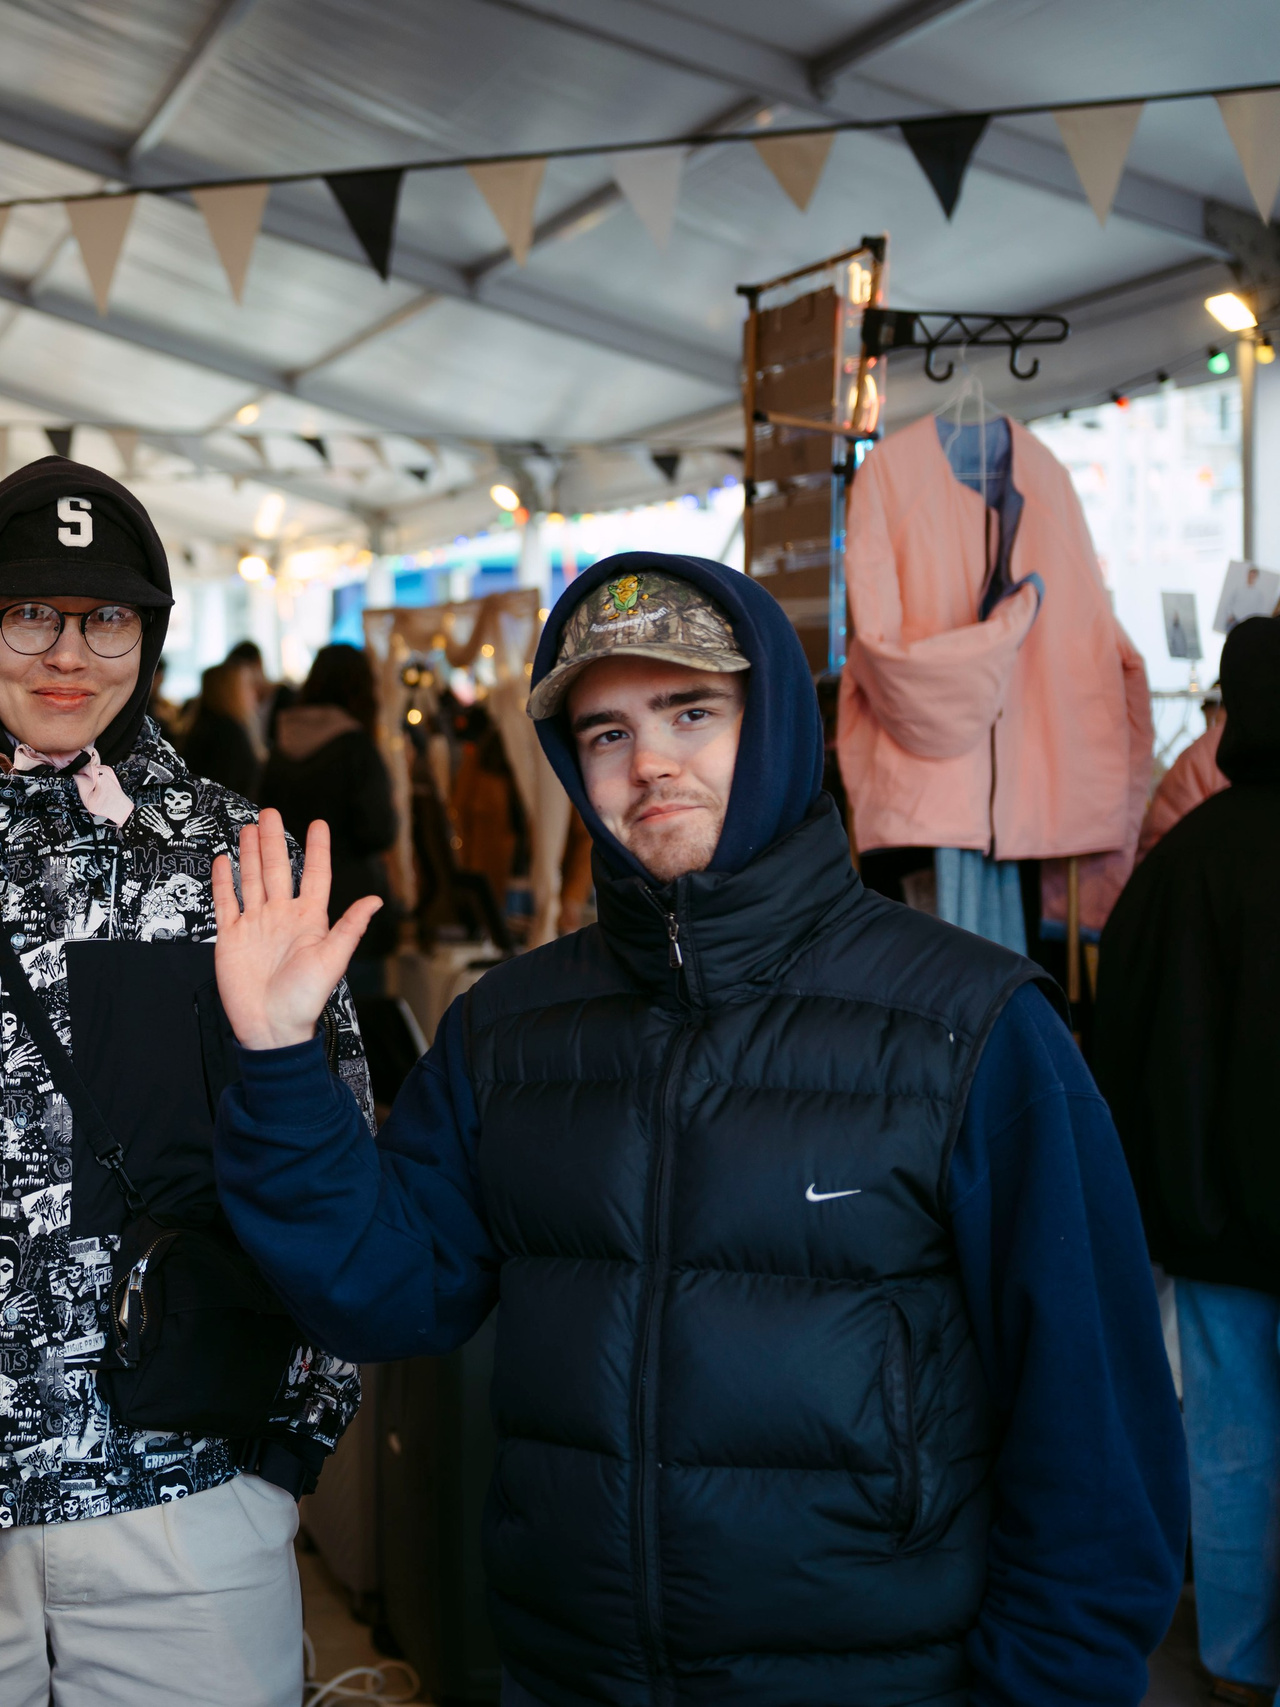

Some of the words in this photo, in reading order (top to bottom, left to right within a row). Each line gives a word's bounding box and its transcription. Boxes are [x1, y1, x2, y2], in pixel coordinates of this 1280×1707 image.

[57, 496, 93, 547] S
[122, 850, 132, 859] 28
[133, 847, 210, 875] MISFITS
[191, 921, 217, 933] darlin
